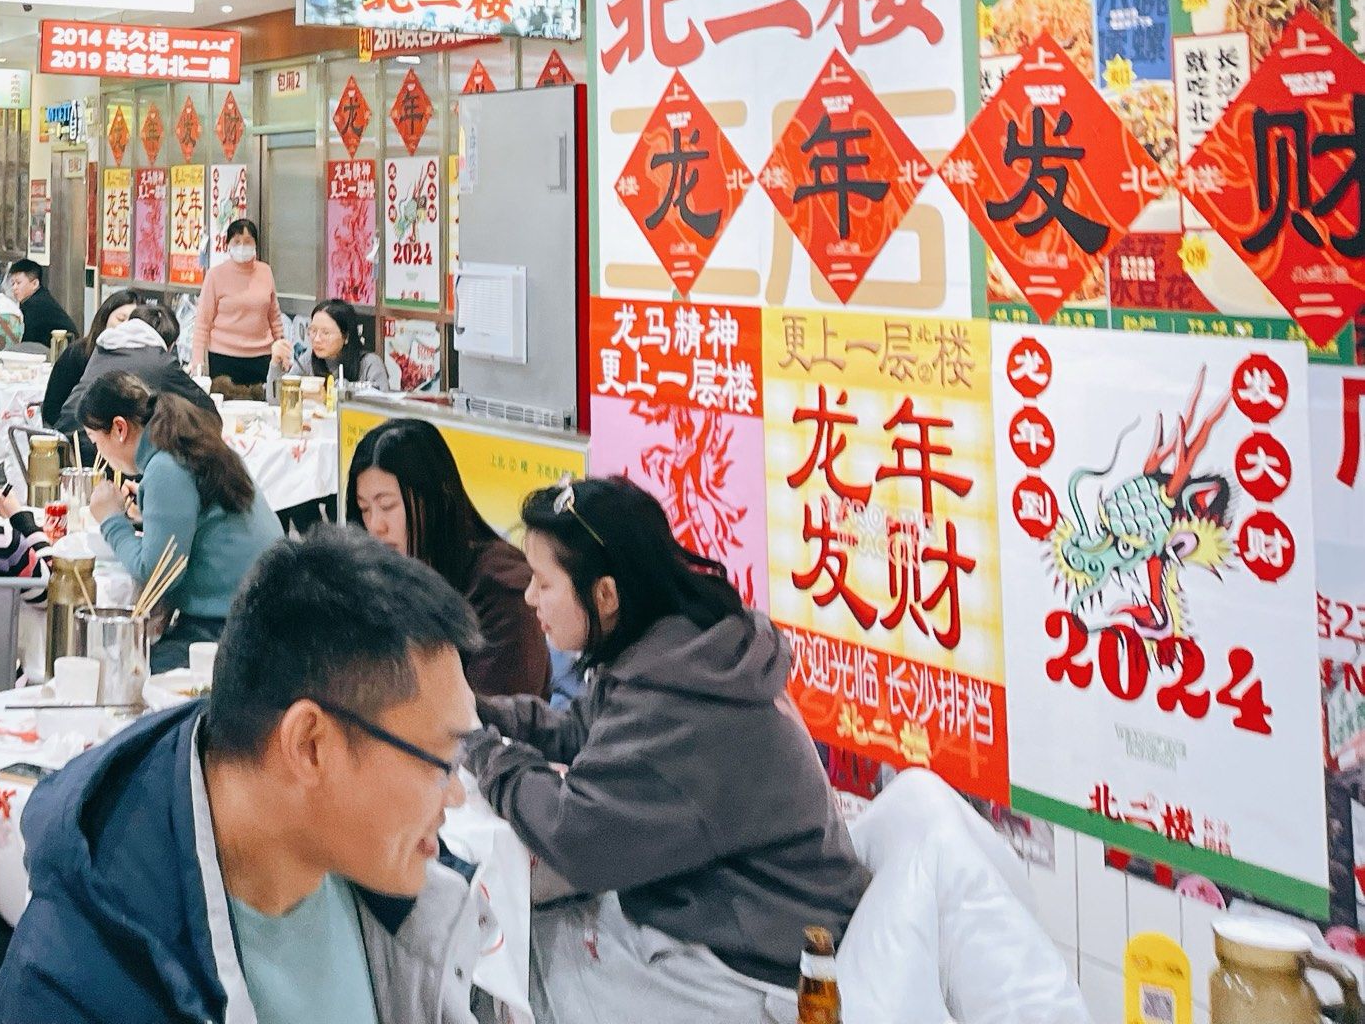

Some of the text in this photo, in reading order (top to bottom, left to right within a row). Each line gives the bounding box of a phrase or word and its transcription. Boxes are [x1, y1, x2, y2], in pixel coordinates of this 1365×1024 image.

[50, 50, 102, 70] 2019
[51, 27, 102, 47] 2014
[1024, 47, 1064, 72] 上
[1279, 30, 1332, 59] 上
[665, 84, 690, 103] 上
[822, 64, 851, 85] 上
[645, 93, 1365, 259] 龙 年 发 财
[393, 241, 433, 266] 2024
[610, 304, 740, 360] 龙马精神
[596, 348, 758, 416] 更上一层楼
[786, 383, 975, 533] 龙年
[1010, 349, 1054, 525] 龙年到
[1236, 367, 1290, 567] 发大财
[791, 504, 977, 651] 发财
[885, 654, 994, 746] 长沙排档
[1045, 609, 1273, 737] 2024
[837, 702, 932, 768] 北二楼
